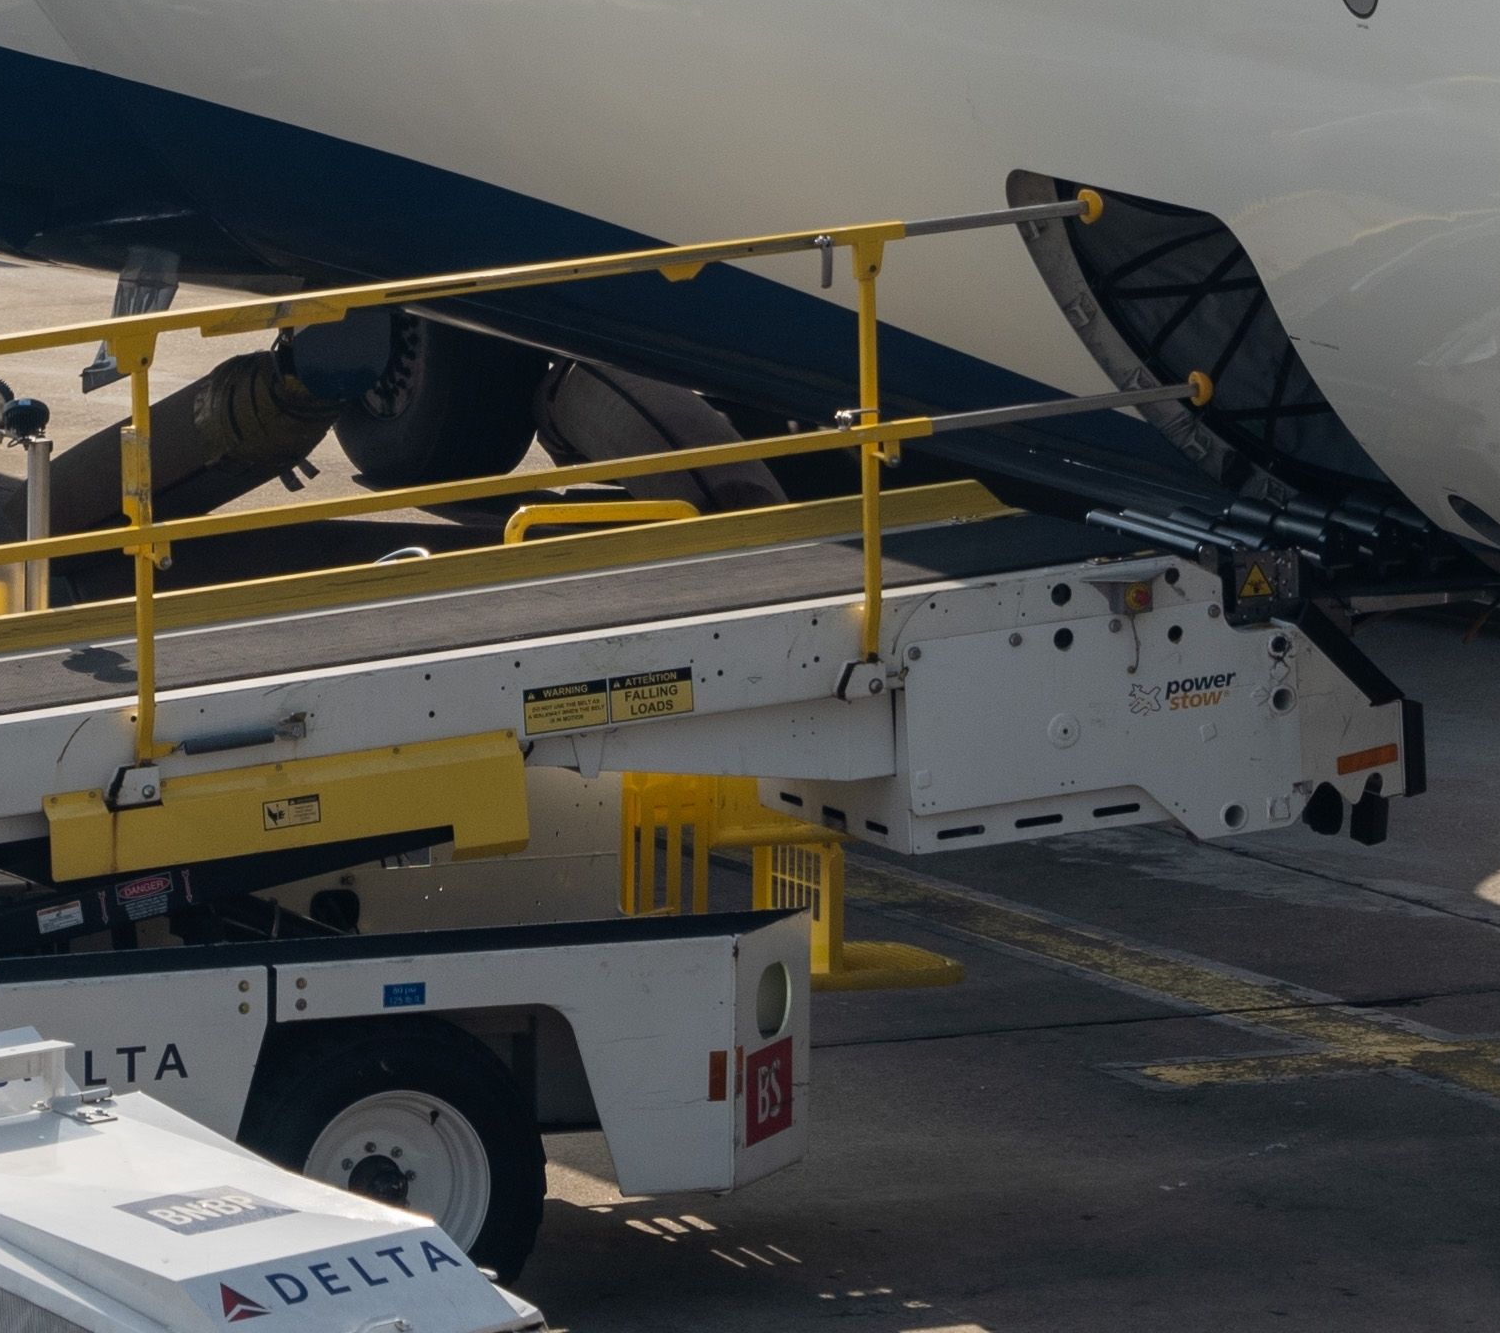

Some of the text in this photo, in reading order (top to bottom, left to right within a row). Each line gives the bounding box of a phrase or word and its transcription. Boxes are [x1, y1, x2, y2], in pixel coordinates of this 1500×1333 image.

[625, 671, 677, 687] ATTENTION
[1165, 672, 1236, 700] power
[543, 685, 588, 698] WARNING
[625, 684, 678, 702] FALLING
[630, 700, 674, 716] LOADS
[1170, 690, 1223, 711] stow
[124, 880, 164, 896] DANGER
[264, 1240, 463, 1305] DELTA
